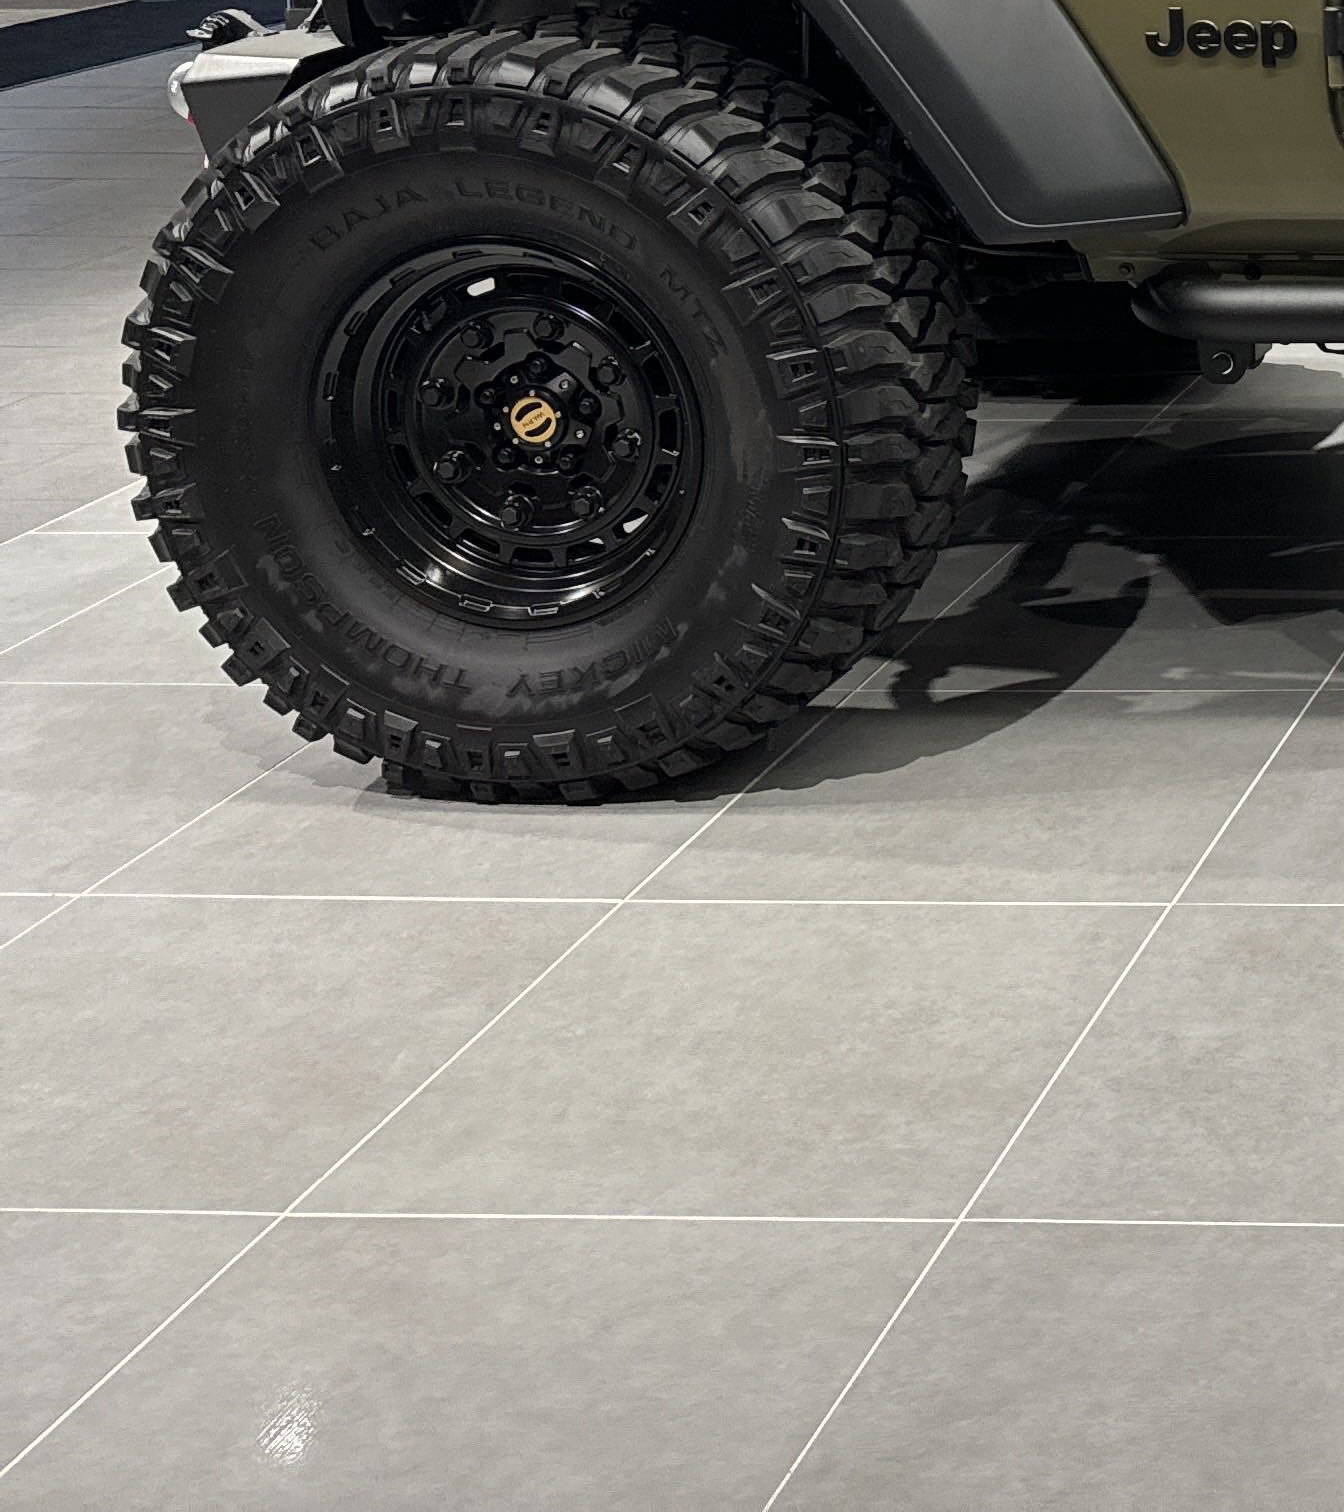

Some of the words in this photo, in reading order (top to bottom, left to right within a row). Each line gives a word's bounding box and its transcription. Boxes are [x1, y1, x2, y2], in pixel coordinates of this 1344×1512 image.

[1145, 6, 1297, 68] Jeep
[308, 185, 429, 251] BAJA
[454, 177, 638, 251] LEGEND
[254, 512, 471, 690] THOMPSON
[505, 614, 684, 697] MICKEY
